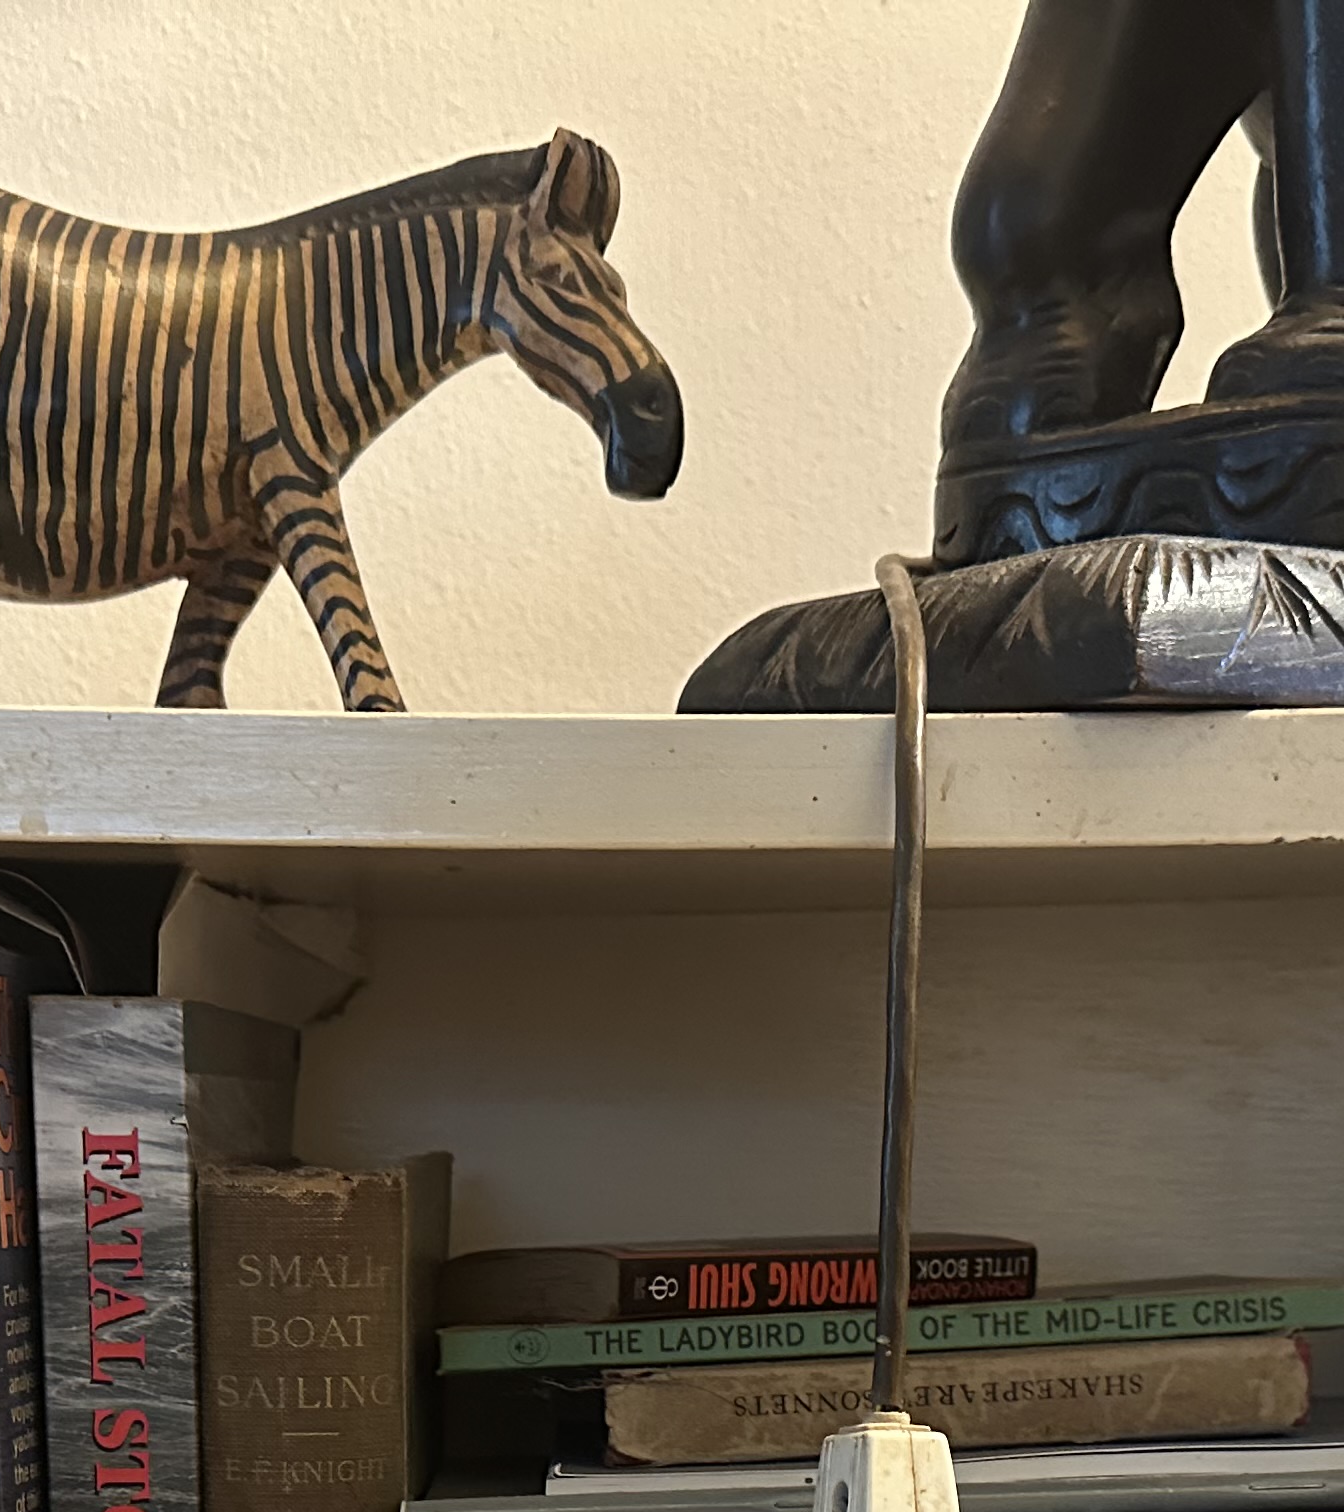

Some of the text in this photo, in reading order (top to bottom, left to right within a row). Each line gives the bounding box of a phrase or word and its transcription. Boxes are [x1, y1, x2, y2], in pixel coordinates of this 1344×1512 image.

[81, 1125, 148, 1387] FATAL
[237, 1252, 391, 1289] SMALL
[915, 1255, 1030, 1280] LITTLE BOOK
[687, 1261, 759, 1310] SHUI
[767, 1258, 879, 1308] WRONG
[250, 1314, 370, 1349] BOAT
[584, 1295, 1287, 1357] THE LADYBIRD BOO OF THE MID-LIFE CRISIS
[215, 1374, 396, 1411] SAILING
